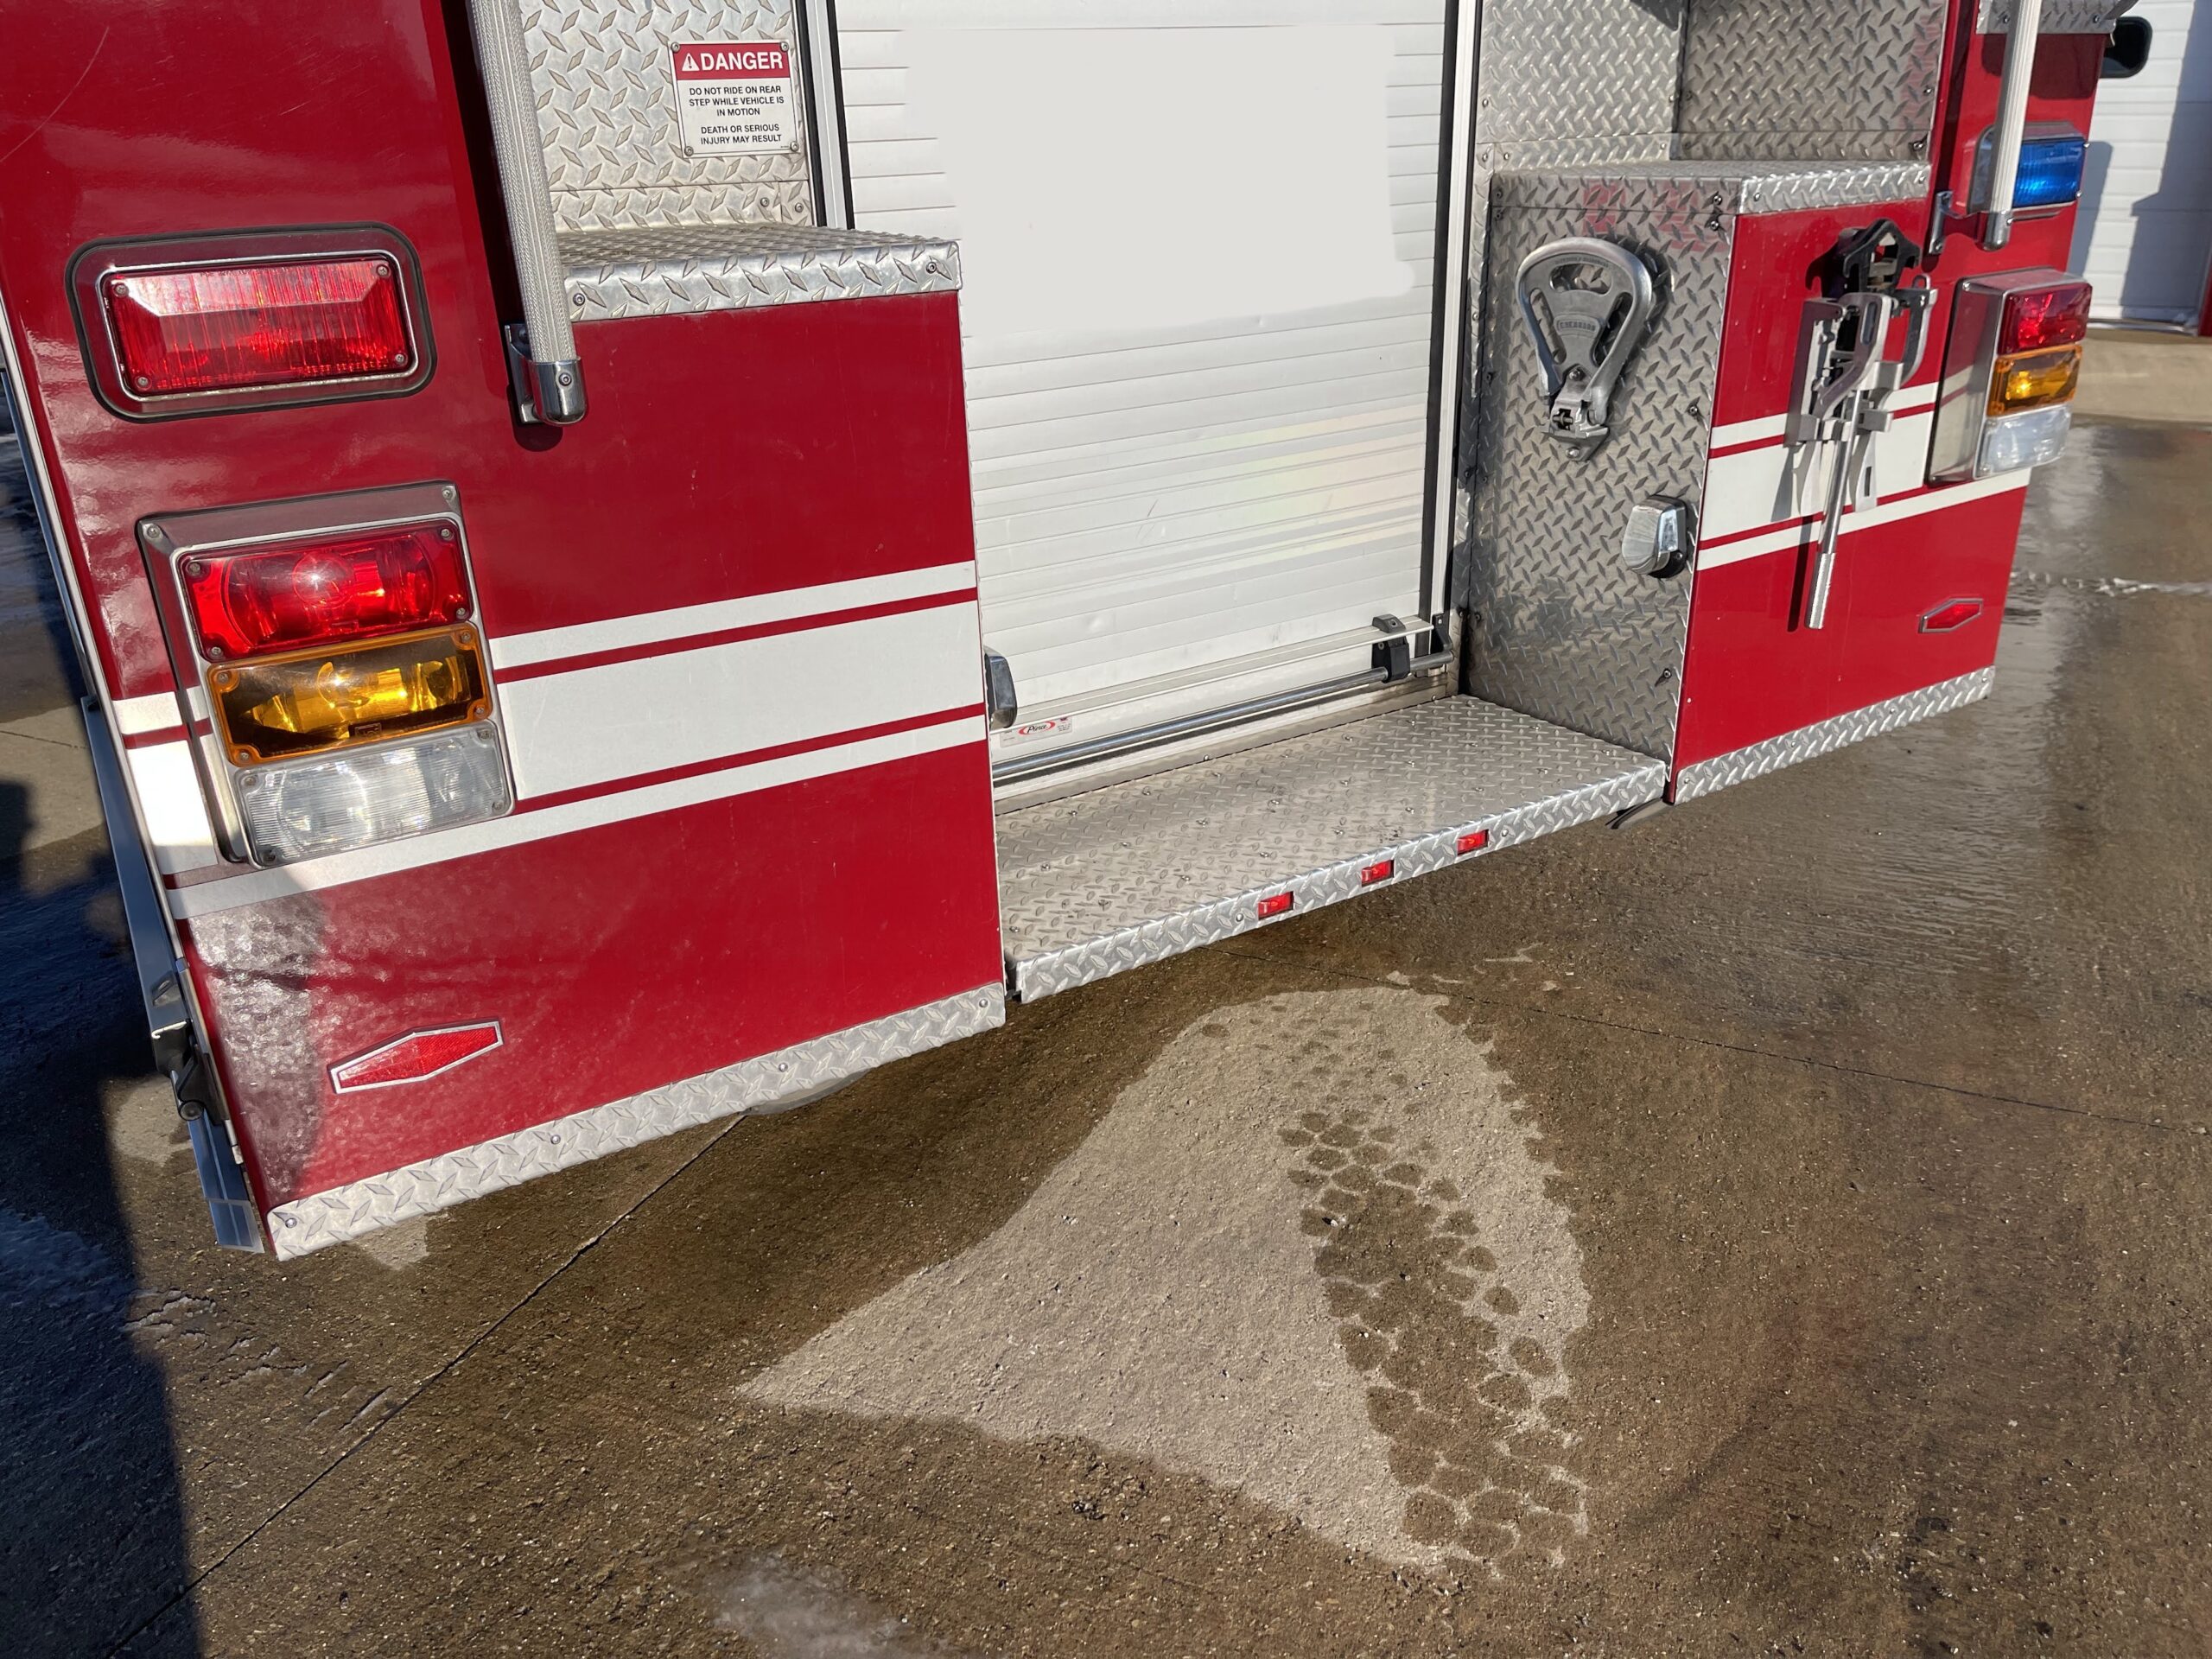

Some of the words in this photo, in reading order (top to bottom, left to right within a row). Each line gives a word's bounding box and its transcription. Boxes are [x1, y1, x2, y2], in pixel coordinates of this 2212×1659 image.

[700, 52, 784, 71] DANGER
[745, 86, 758, 94] ON
[744, 124, 779, 132] SERIOUS
[752, 134, 782, 143] RESULT
